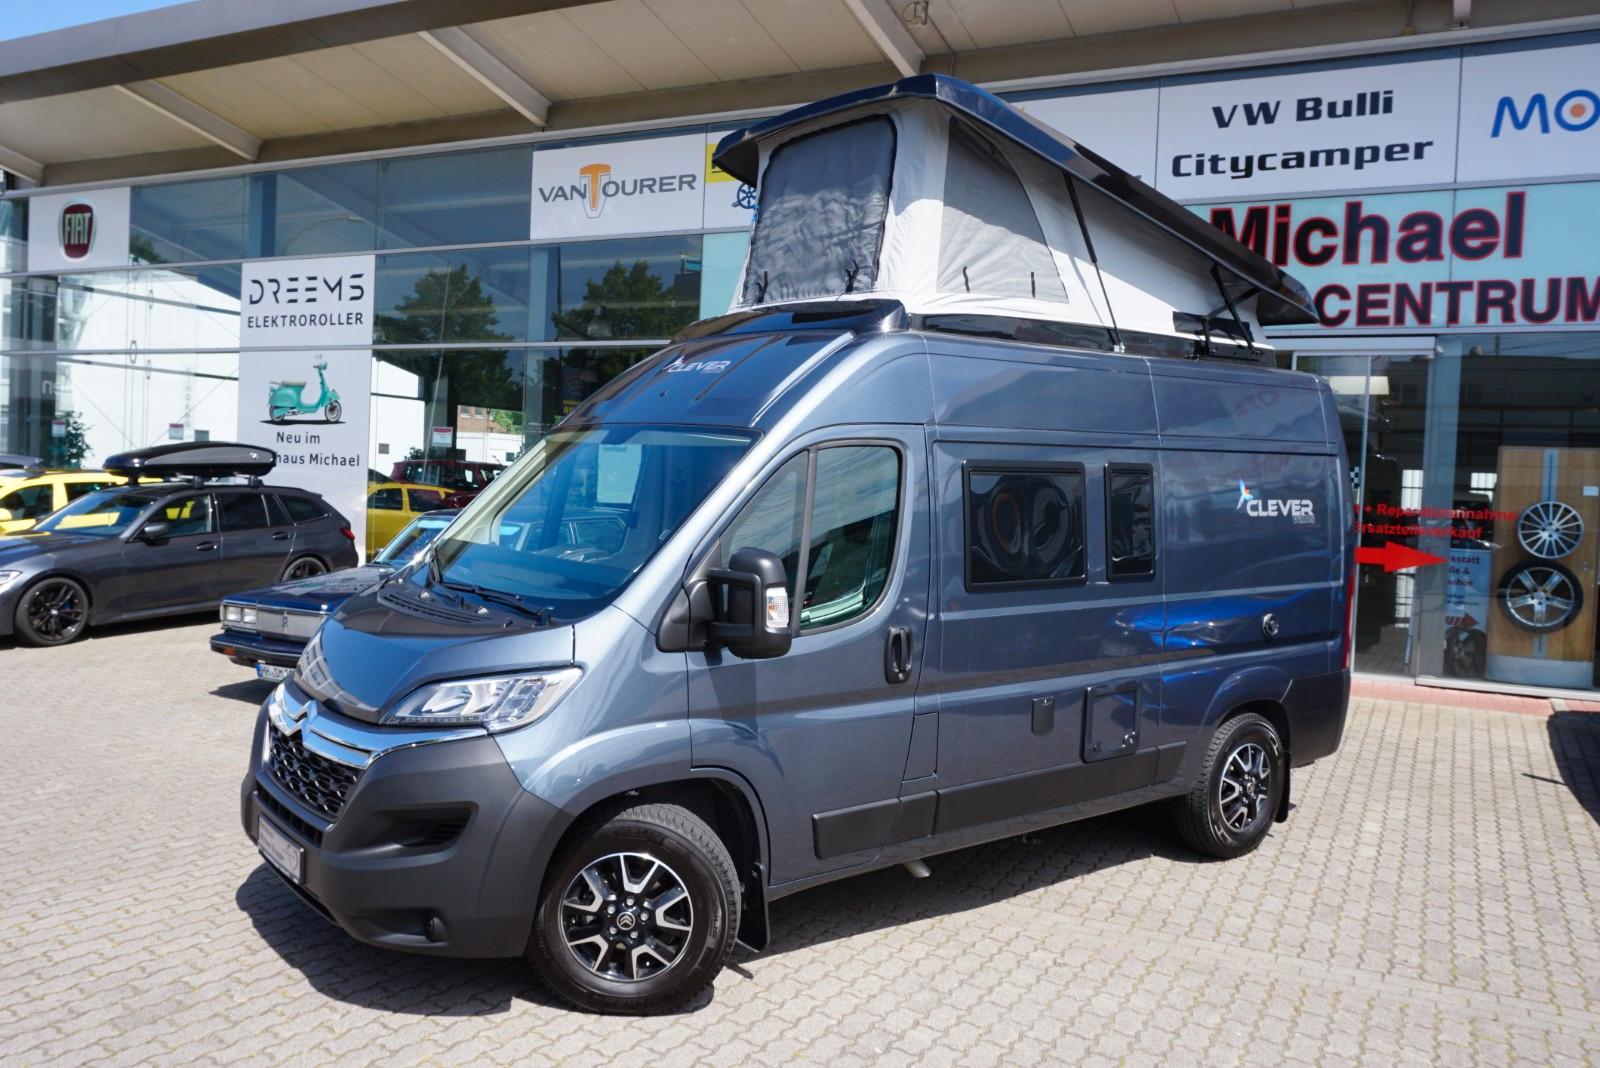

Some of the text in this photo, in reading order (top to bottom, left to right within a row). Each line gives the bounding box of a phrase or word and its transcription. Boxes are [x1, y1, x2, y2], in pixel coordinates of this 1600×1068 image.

[1211, 90, 1393, 129] VW Bulli
[1171, 140, 1434, 179] Citycamper
[538, 163, 697, 209] VANTOURER
[64, 212, 92, 245] FIAT
[1210, 191, 1526, 267] Michael
[249, 273, 364, 305] DREEMS
[247, 312, 363, 328] ELEKTROROLLER
[276, 431, 320, 443] Neu im
[309, 453, 360, 466] Michael
[1246, 499, 1314, 517] CLEVER
